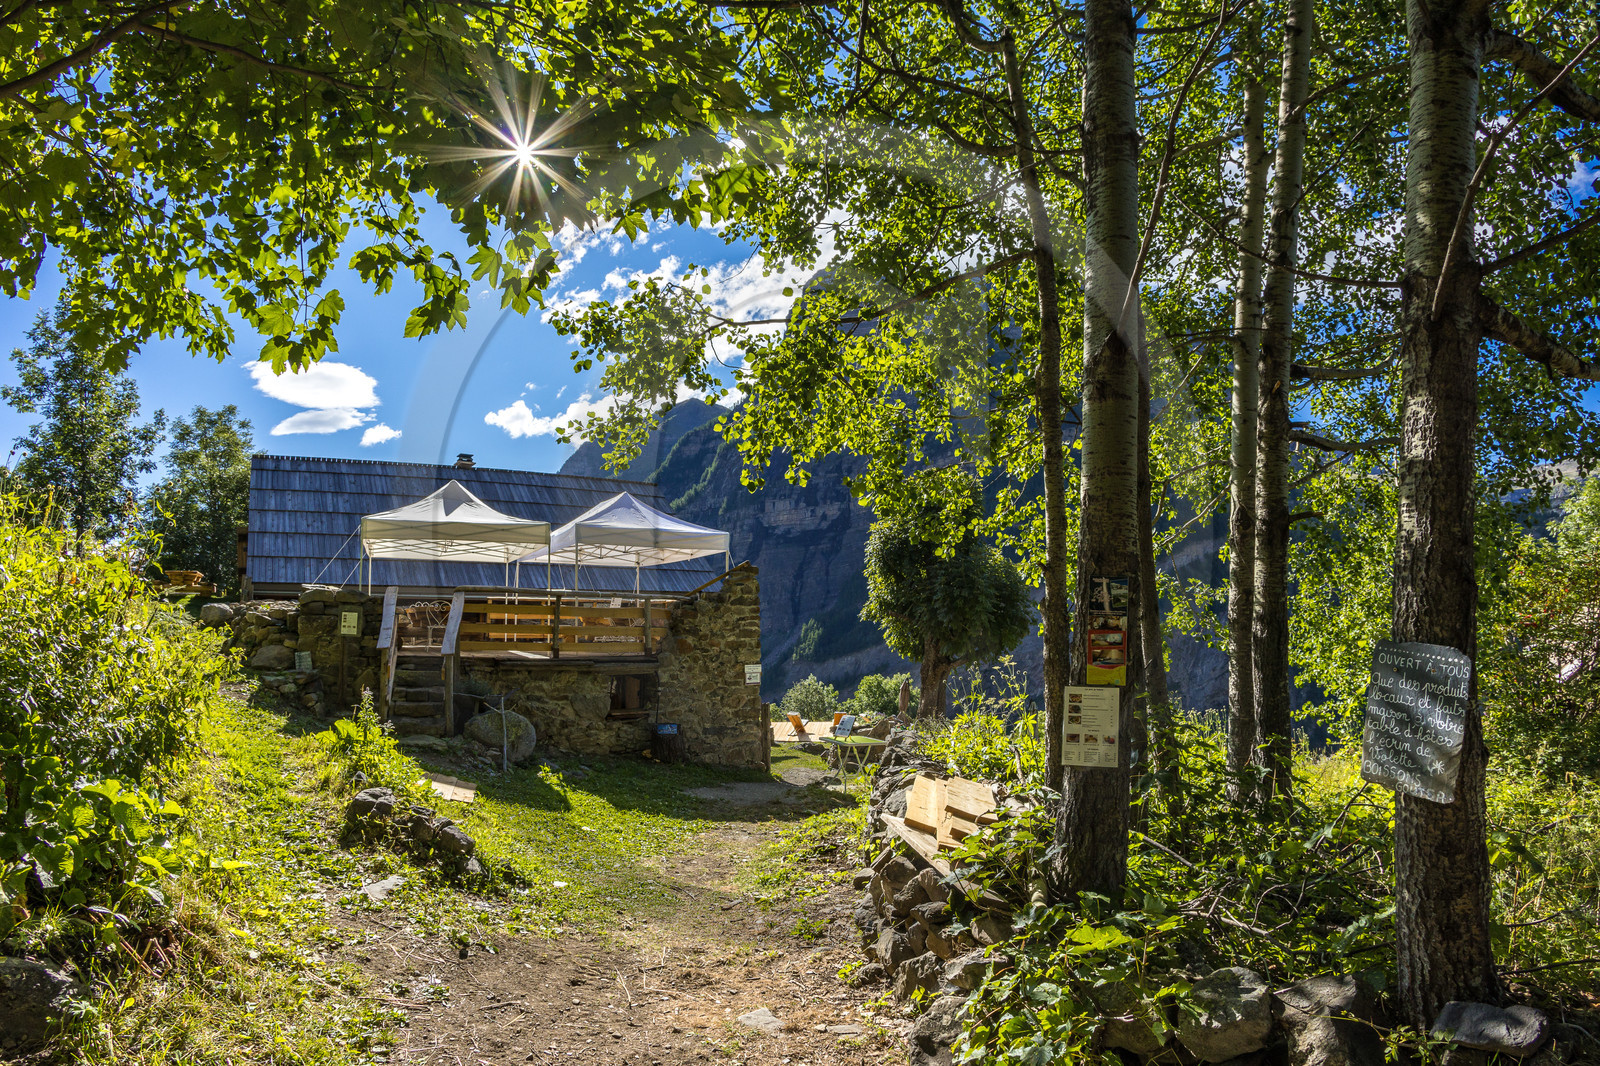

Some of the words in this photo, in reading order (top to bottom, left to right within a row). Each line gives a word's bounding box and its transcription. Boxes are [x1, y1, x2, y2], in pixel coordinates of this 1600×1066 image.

[1379, 653, 1421, 670] OUVERT
[1440, 664, 1469, 678] TOUS
[1372, 672, 1393, 689] Que
[1399, 672, 1420, 691] des
[1422, 679, 1468, 700] produits
[1370, 687, 1415, 706] locaux
[1418, 695, 1431, 709] et
[1435, 696, 1465, 719] faits
[1368, 705, 1410, 720] maison
[1428, 715, 1464, 734] votre
[1368, 718, 1401, 735] table
[1416, 743, 1431, 757] de
